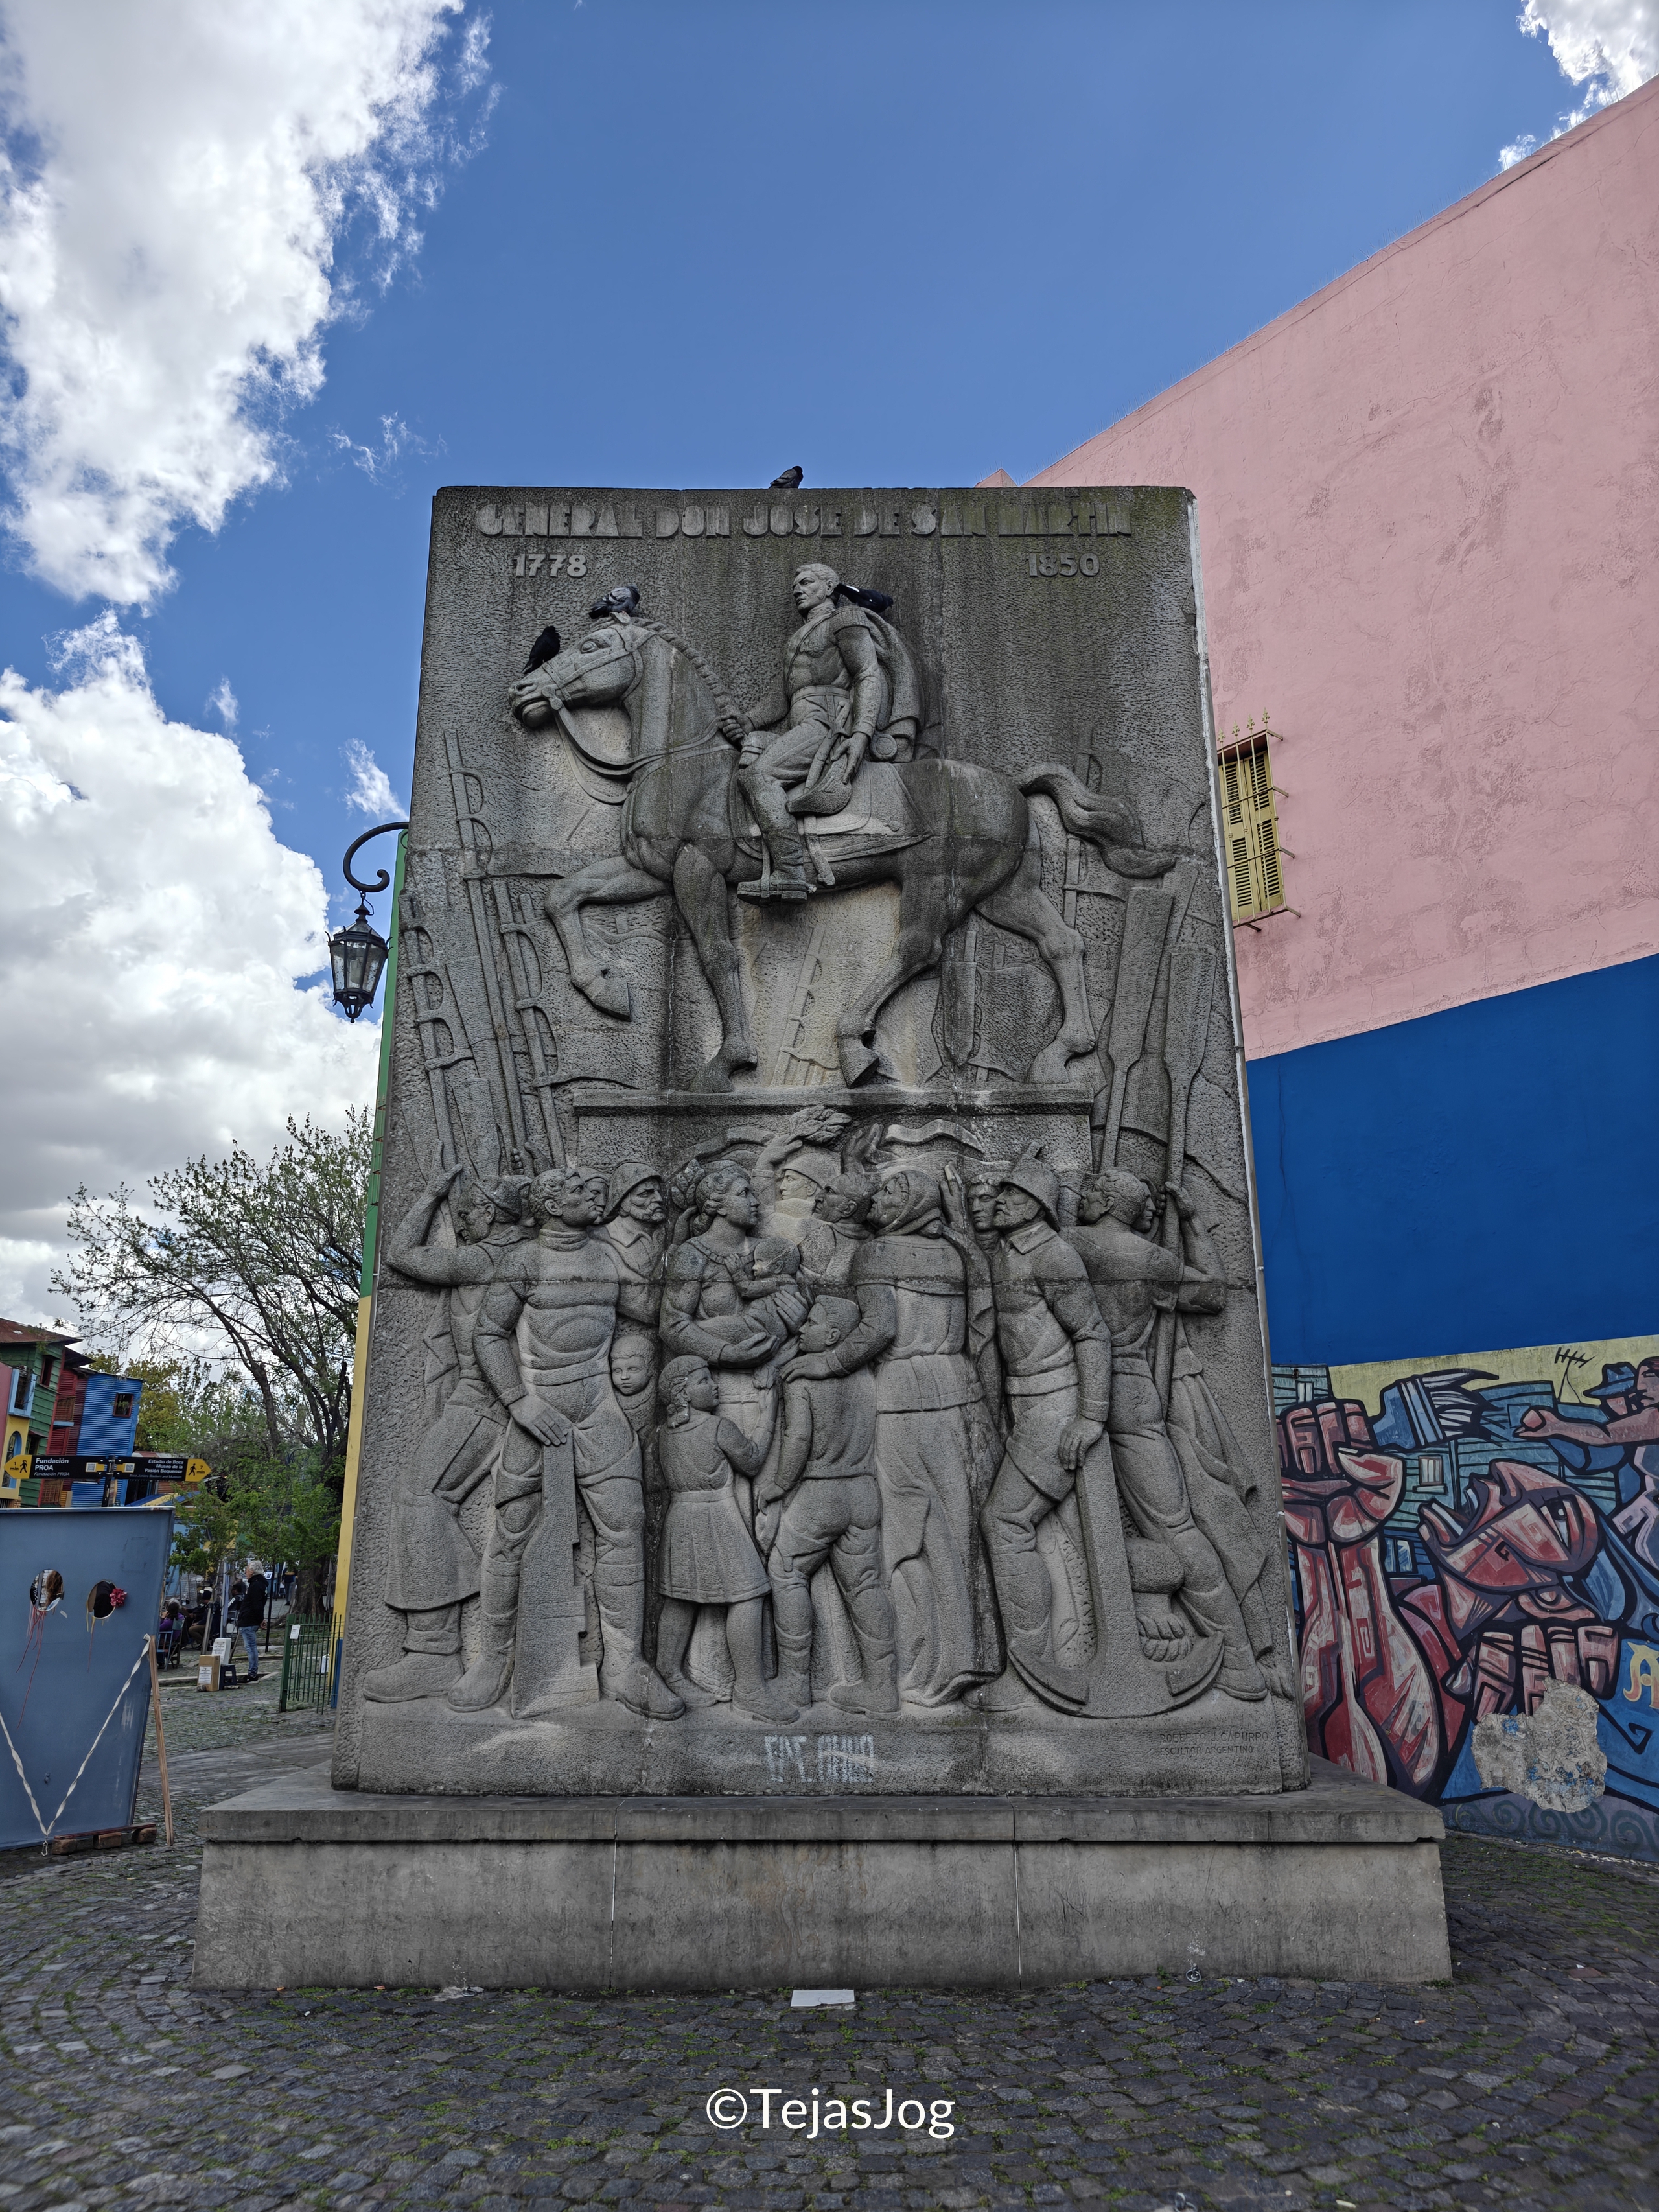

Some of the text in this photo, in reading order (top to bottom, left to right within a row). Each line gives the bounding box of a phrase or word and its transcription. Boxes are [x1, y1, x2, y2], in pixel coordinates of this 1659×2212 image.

[475, 504, 1132, 539] GENERAL DON JOSE DE SAN MARTIN
[514, 553, 588, 578] 1778
[1028, 552, 1100, 577] 1850
[1205, 1745, 1253, 1754] ARGENTINO
